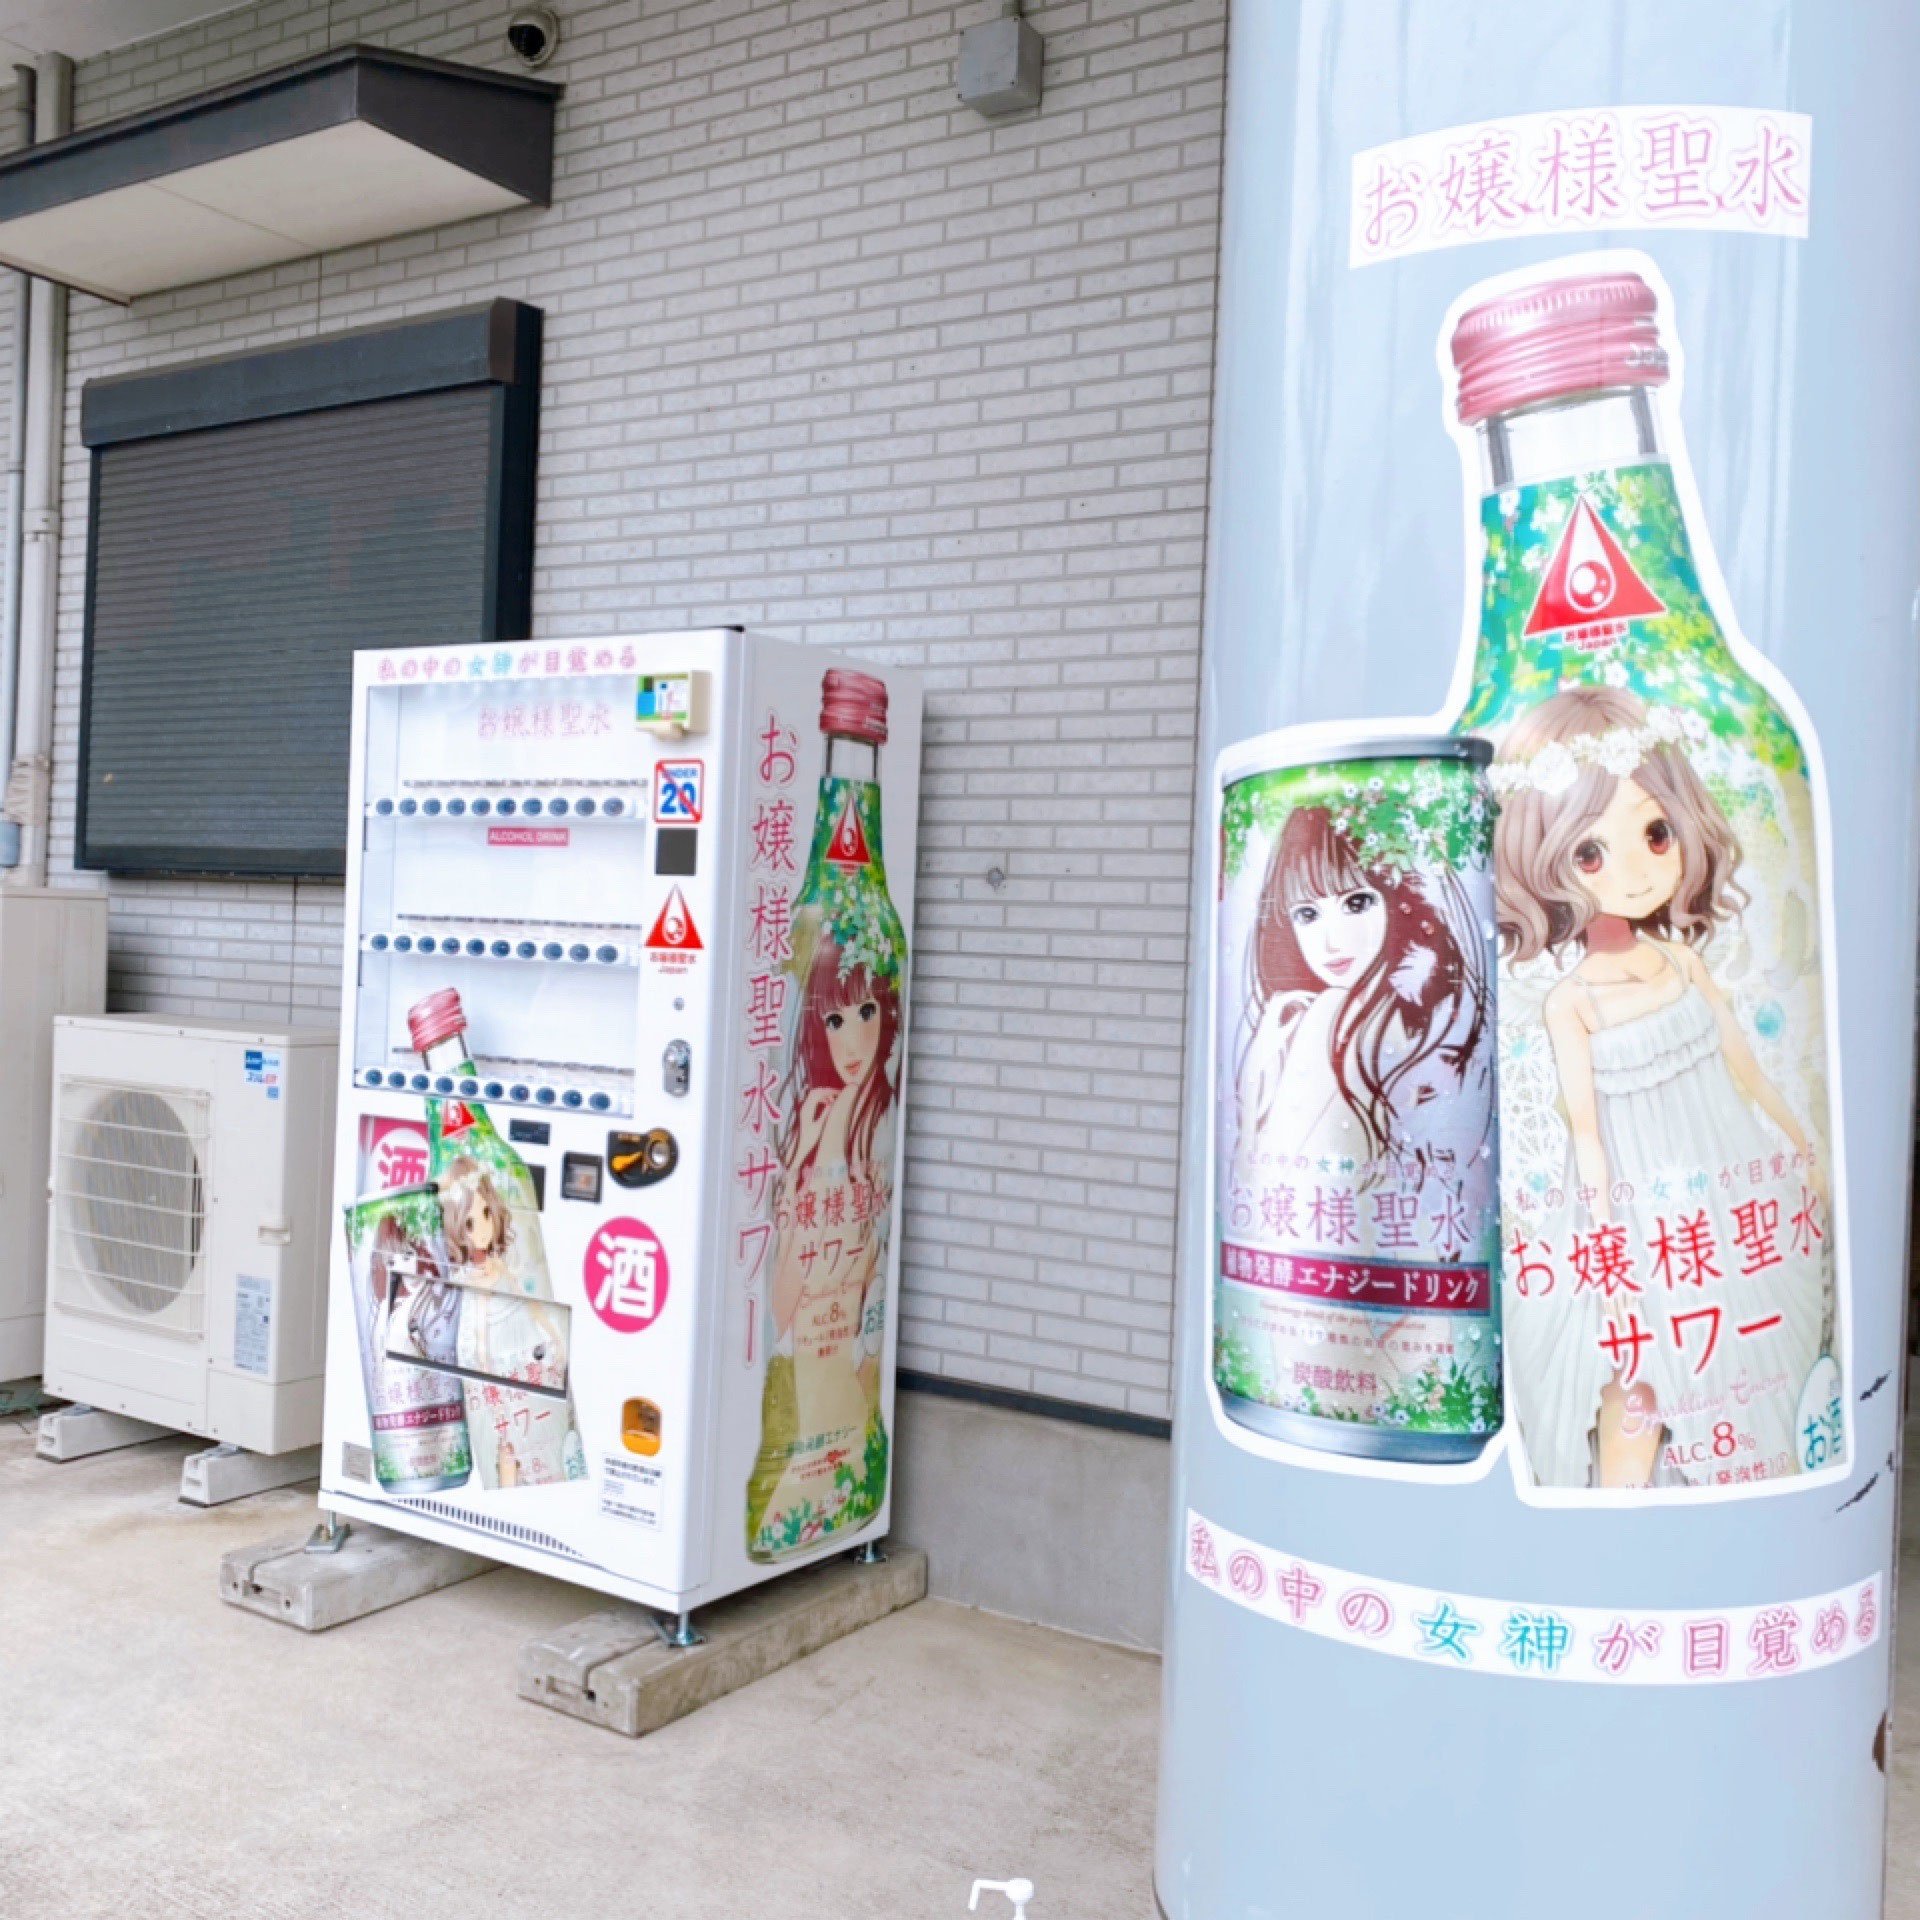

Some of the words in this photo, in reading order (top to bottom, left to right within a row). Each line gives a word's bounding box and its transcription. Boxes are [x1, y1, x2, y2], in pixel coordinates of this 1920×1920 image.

[1364, 114, 1808, 248] お嬢様聖水
[378, 646, 637, 681] 私の中の女神が目覚める
[478, 702, 612, 738] お嬢様聖水
[660, 782, 697, 815] 20
[489, 831, 535, 843] ALCOHOL
[537, 831, 567, 843] DRINK
[738, 713, 798, 1364] お嬢様聖水サワー
[1231, 1182, 1474, 1251] お嬢様聖水
[1510, 1185, 1823, 1298] お嬢様聖水
[595, 1231, 659, 1320] 酒
[797, 1238, 865, 1279] サワー
[1597, 1306, 1783, 1386] サワー
[1188, 1520, 1876, 1674] 私の中の女神が目覚める
